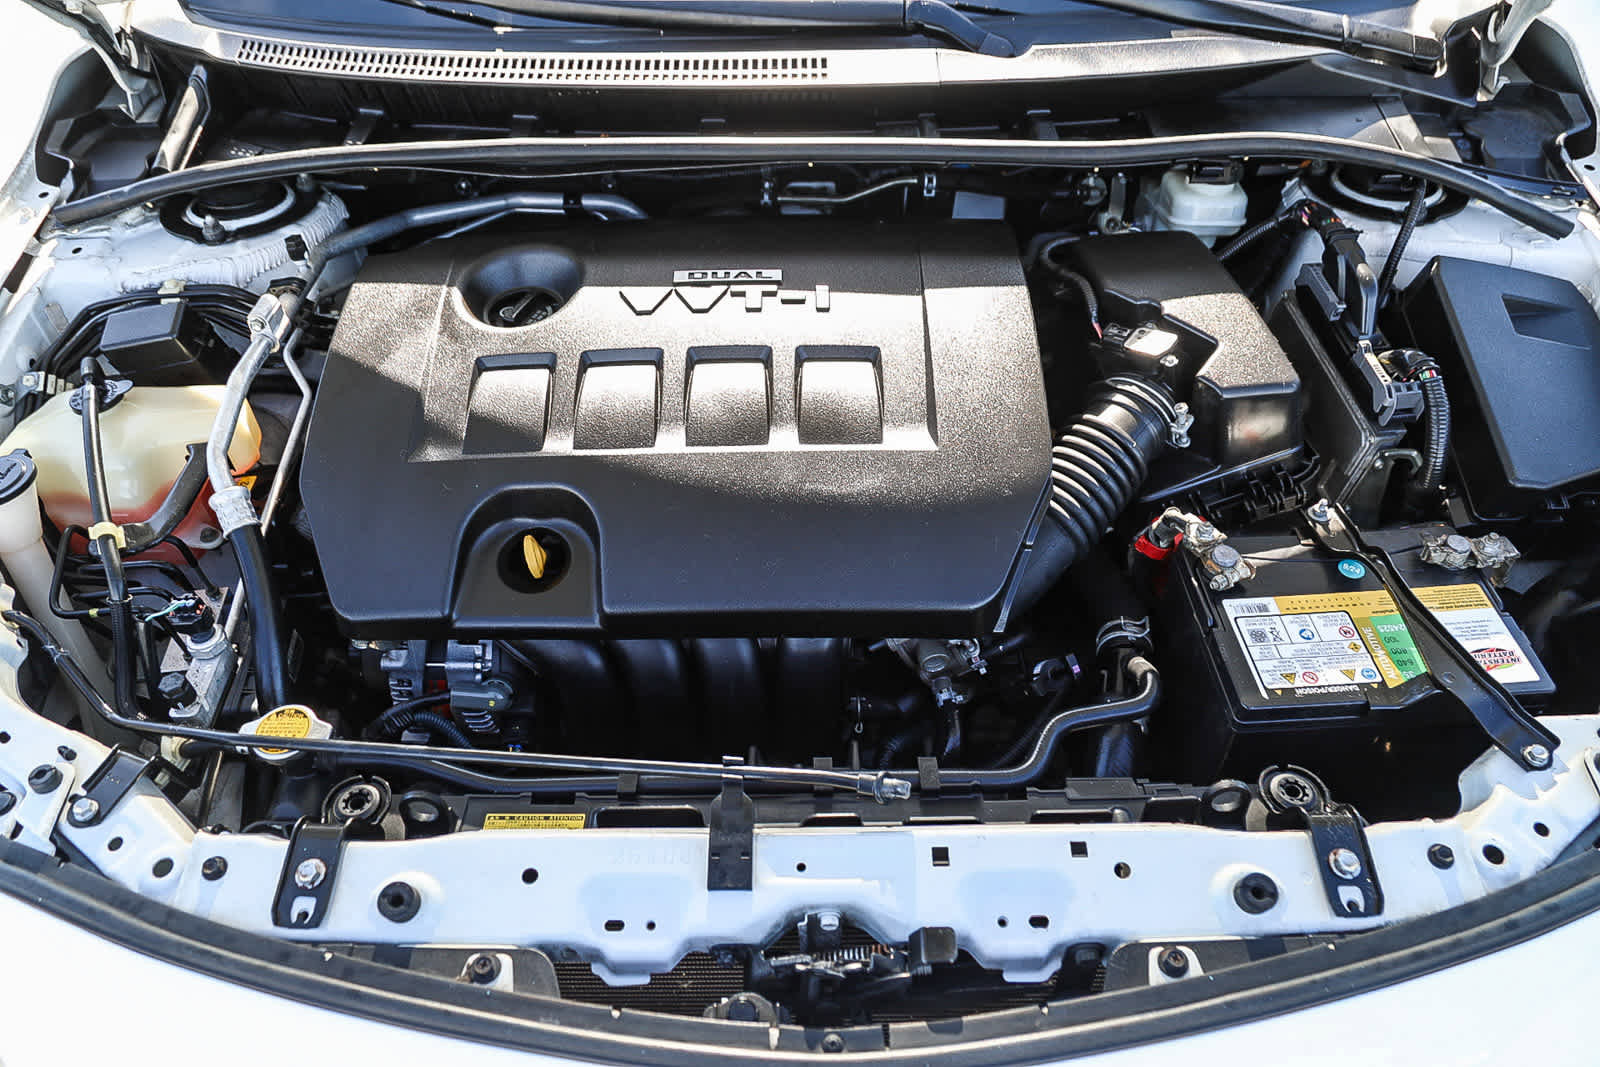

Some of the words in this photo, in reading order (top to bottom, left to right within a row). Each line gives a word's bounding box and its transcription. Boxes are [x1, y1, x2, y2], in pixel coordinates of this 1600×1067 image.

[688, 271, 773, 280] DUAL
[1361, 627, 1399, 680] AUTOMOTIVE
[1473, 650, 1514, 659] BATTERI
[1479, 656, 1521, 665] INTERST
